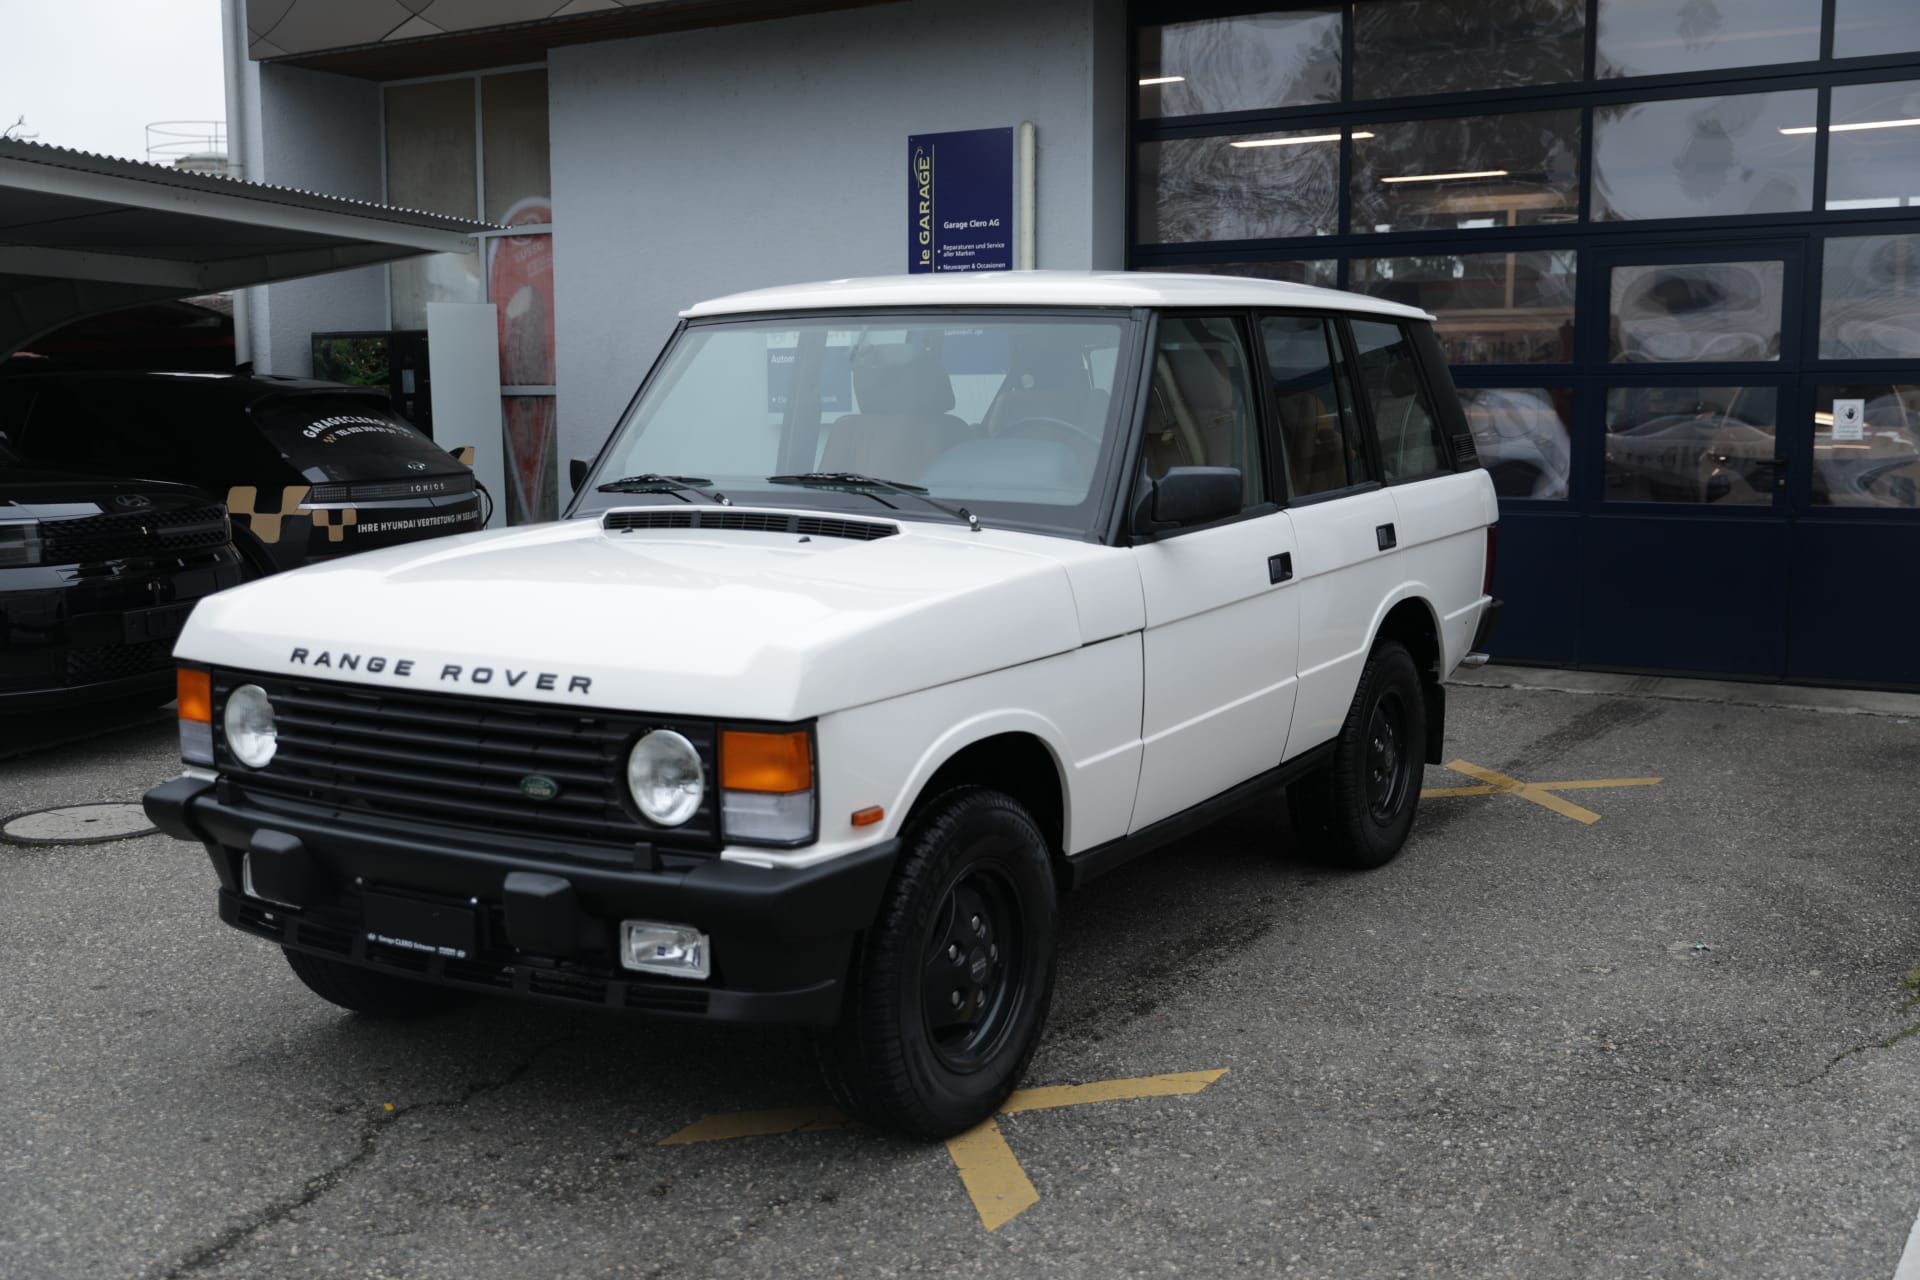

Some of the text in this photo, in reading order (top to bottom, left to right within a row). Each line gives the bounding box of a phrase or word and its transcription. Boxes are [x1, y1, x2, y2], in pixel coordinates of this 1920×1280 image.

[919, 156, 930, 265] le GARAGE
[943, 218, 1000, 230] Garage Clero AG
[943, 243, 975, 251] Reparaturen
[943, 263, 971, 272] Neuwagen
[357, 522, 379, 534] IHRE
[381, 520, 416, 532] HYUNDAI
[417, 514, 456, 528] VERTRETUNG
[290, 648, 594, 695] RANGE ROVER
